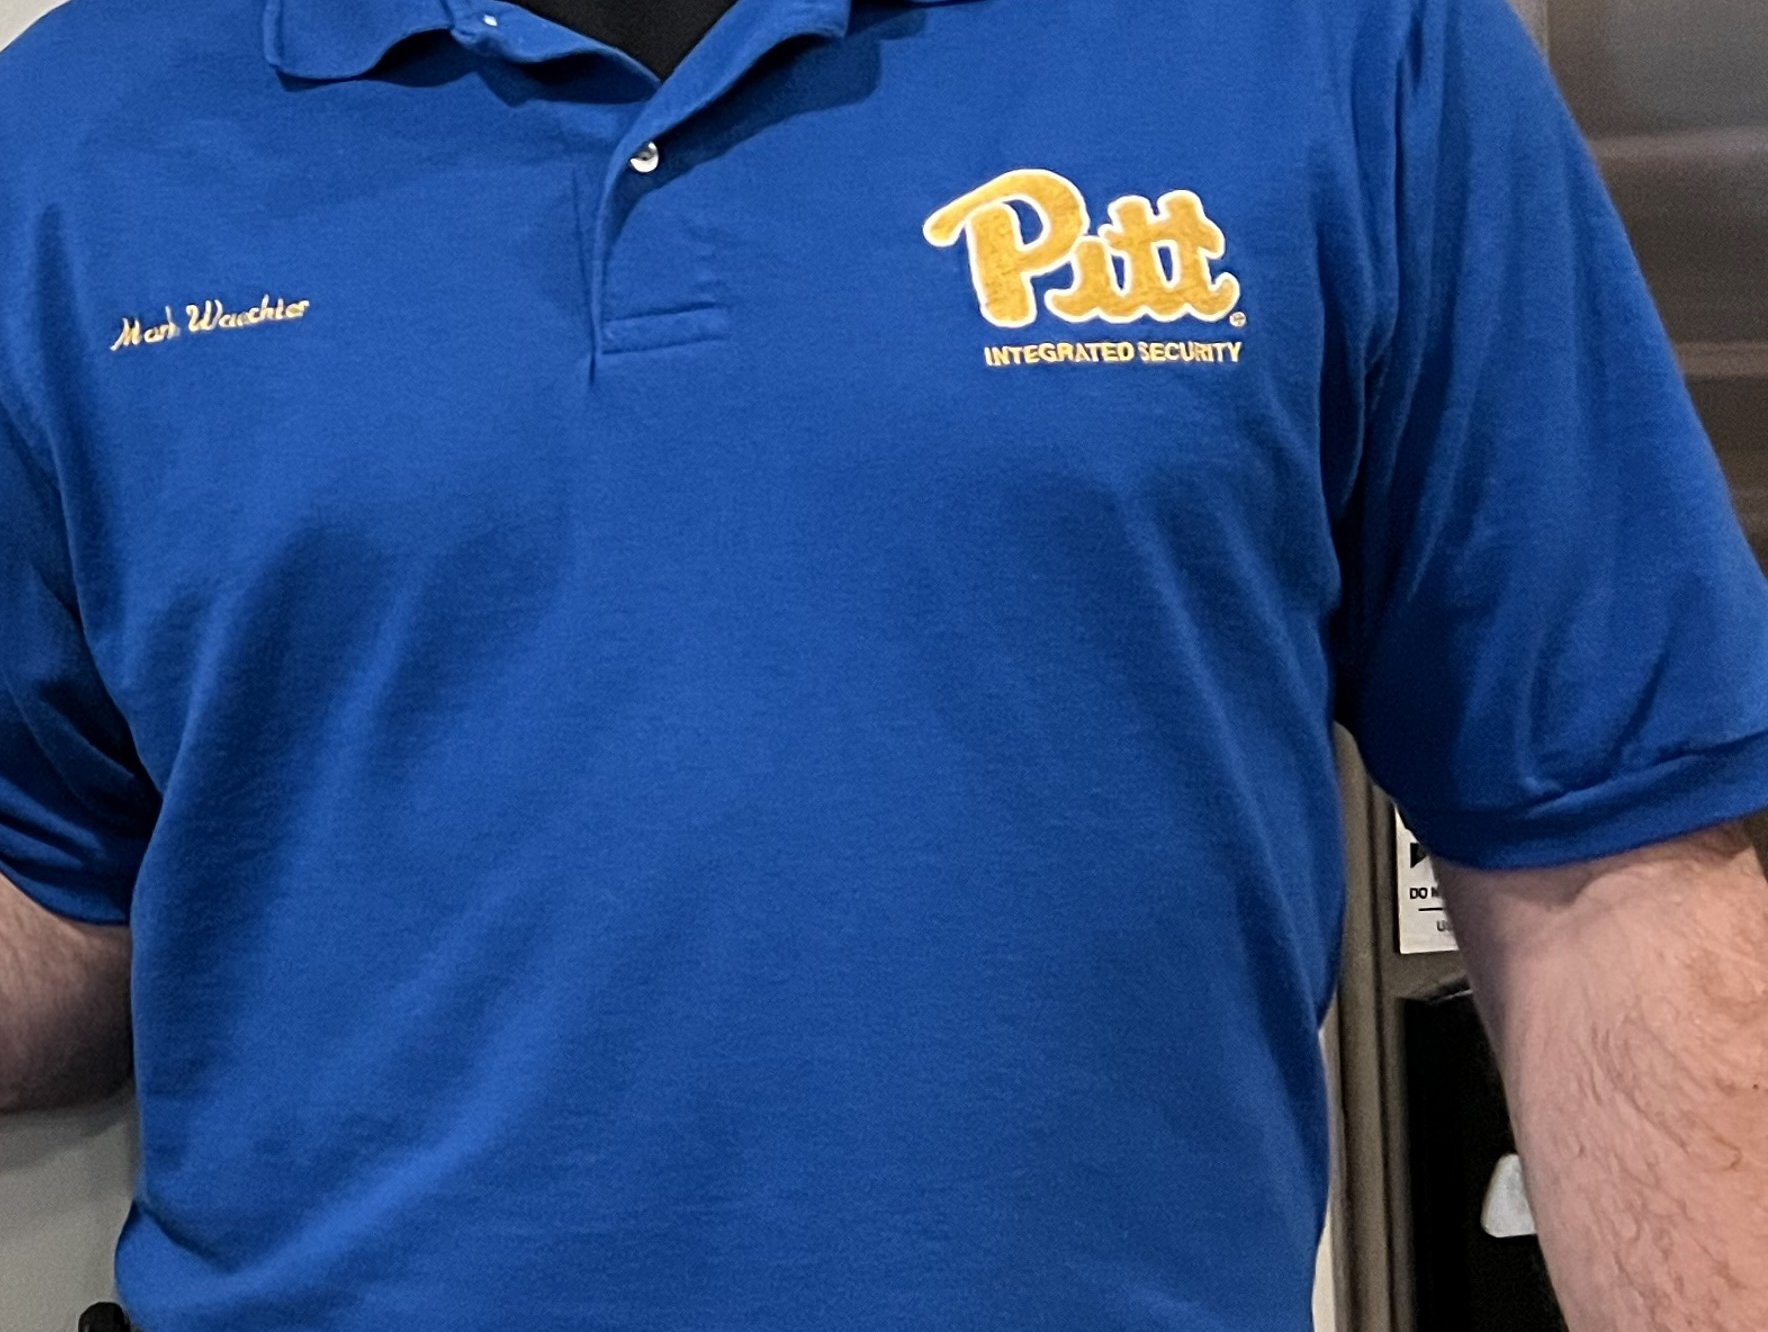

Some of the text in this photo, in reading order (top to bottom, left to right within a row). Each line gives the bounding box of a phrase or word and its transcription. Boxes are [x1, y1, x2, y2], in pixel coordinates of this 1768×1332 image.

[923, 168, 1240, 328] Pitt
[110, 305, 180, 351] Mark
[985, 341, 1241, 367] INTEGRATED SECURITY
[1410, 887, 1428, 899] DO
